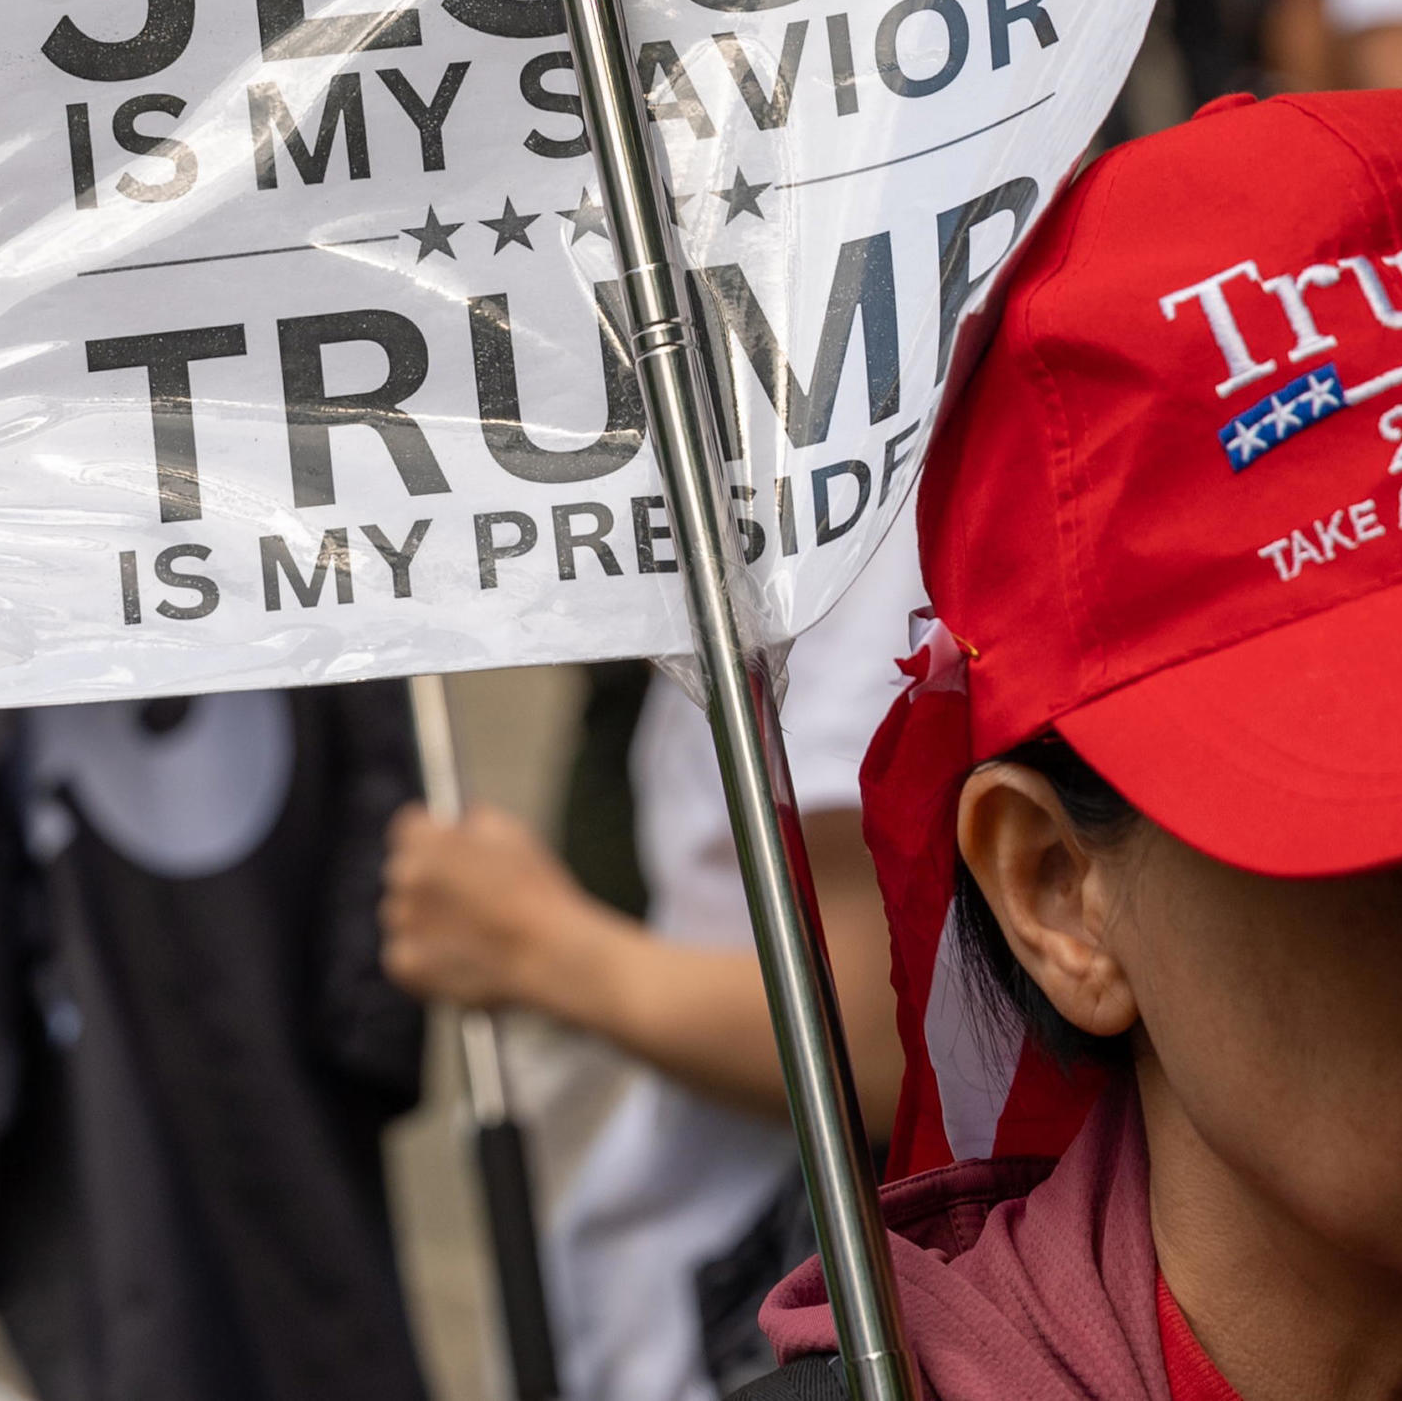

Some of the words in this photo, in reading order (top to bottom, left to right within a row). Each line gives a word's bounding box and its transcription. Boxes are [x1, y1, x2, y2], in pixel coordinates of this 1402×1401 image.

[66, 93, 199, 211] IS
[247, 60, 472, 190] MY
[86, 176, 1040, 524] TRUMP
[118, 543, 221, 626] IS
[260, 518, 435, 612] MY
[1257, 500, 1385, 582] TAKE
